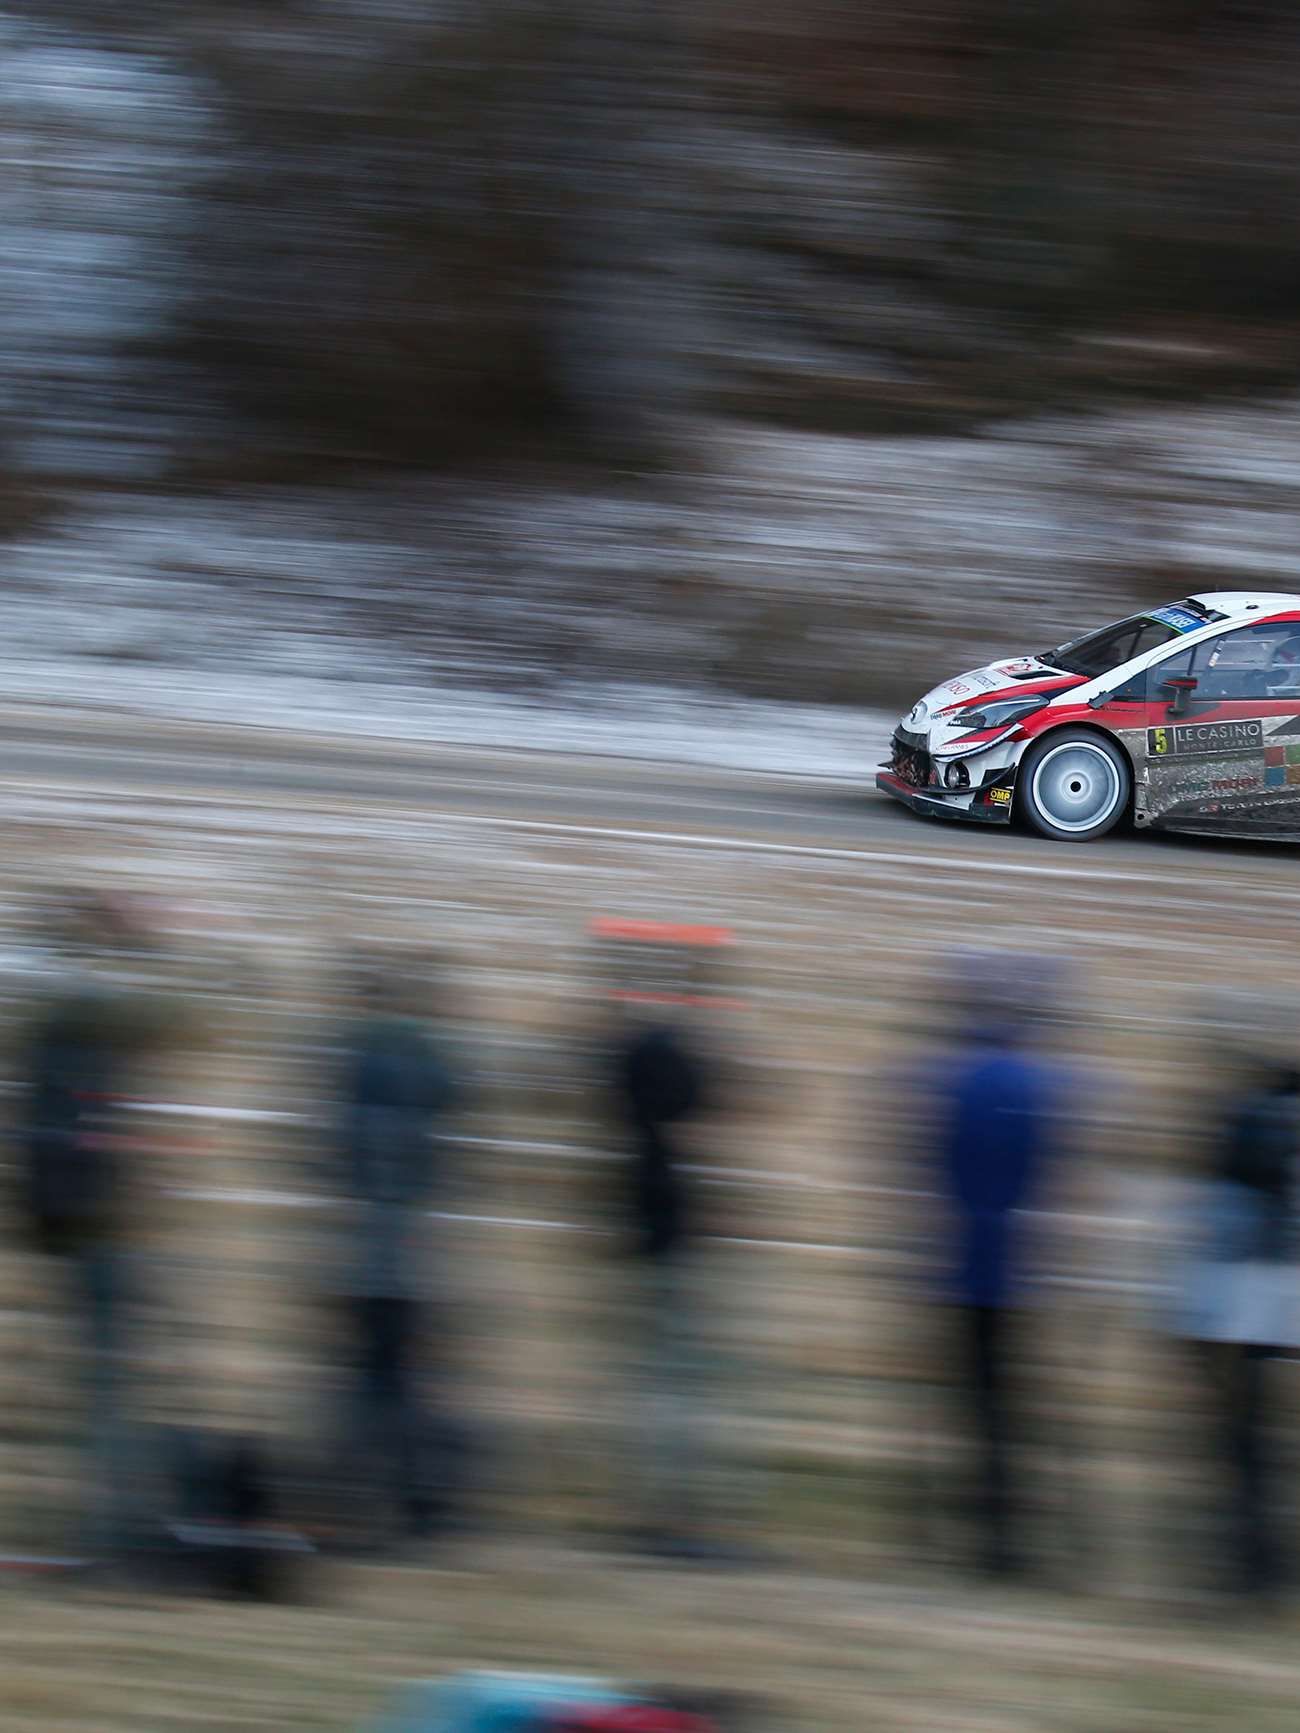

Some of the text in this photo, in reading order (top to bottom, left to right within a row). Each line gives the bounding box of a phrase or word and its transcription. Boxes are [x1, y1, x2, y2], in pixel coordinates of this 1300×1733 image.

[1155, 729, 1168, 753] 5
[1177, 723, 1260, 742] LE CASINO
[990, 788, 1011, 801] OMP
